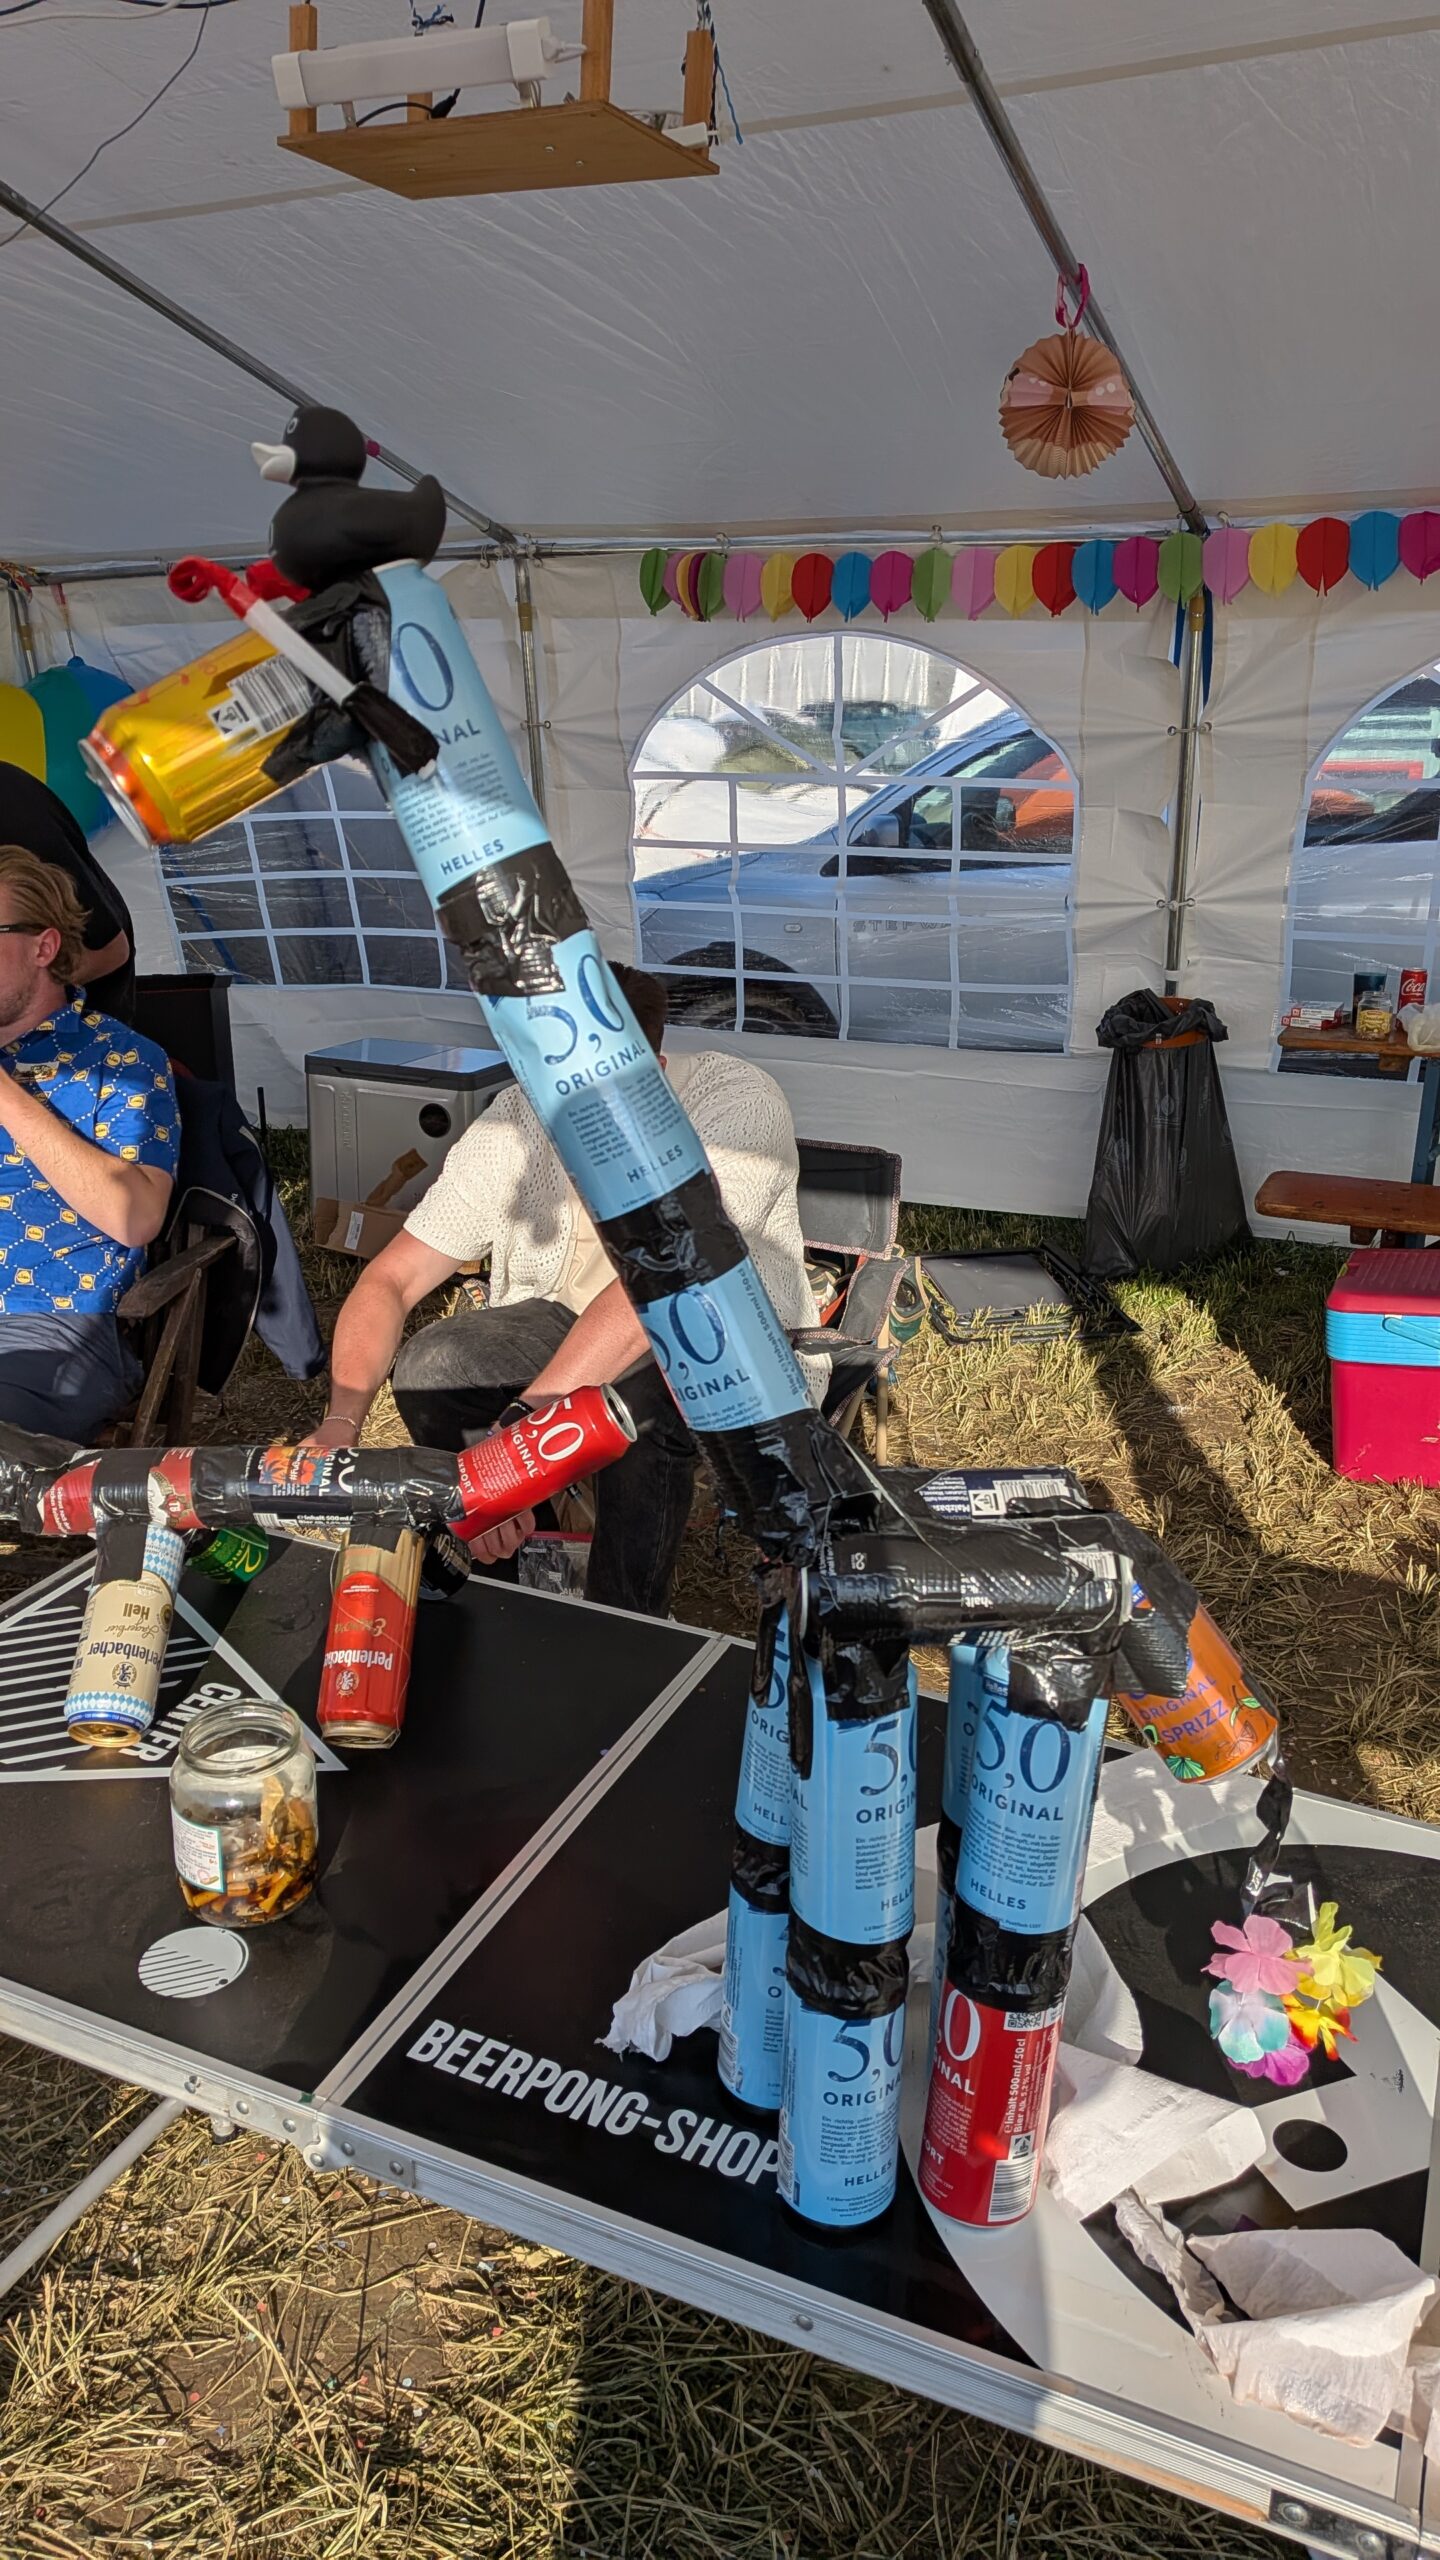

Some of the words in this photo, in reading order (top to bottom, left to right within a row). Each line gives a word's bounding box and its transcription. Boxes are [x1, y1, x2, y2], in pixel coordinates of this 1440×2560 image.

[440, 838, 504, 876] HELLES
[1401, 978, 1425, 996] Coca
[527, 954, 625, 1066] 5,0
[555, 1039, 646, 1096] ORIGINAL
[627, 1144, 684, 1183] HELLES
[673, 1368, 750, 1402] IGINAL
[510, 1424, 540, 1479] IGINAL
[319, 1447, 339, 1496] IGINAL
[123, 1602, 150, 1620] Hell
[104, 1620, 160, 1642] Lagerbier
[87, 1641, 161, 1671] Perlenbacher
[1139, 1675, 1217, 1721] ORIGINAL
[751, 1708, 790, 1743] ORIG
[1160, 1699, 1229, 1744] SPRIZZ
[976, 1699, 1071, 1793] 5,0
[753, 1802, 787, 1826] HELL
[970, 1772, 1064, 1822] ORIGINAL
[970, 1878, 1027, 1911] HELLES
[935, 2052, 975, 2095] INAL
[406, 2018, 779, 2185] BEERPONG-SHOP
[1007, 2097, 1017, 2124] Inhalt
[1013, 2116, 1024, 2133] Bier
[1024, 2063, 1032, 2076] vol
[924, 2137, 944, 2165] ORT
[844, 2159, 892, 2187] HELLES
